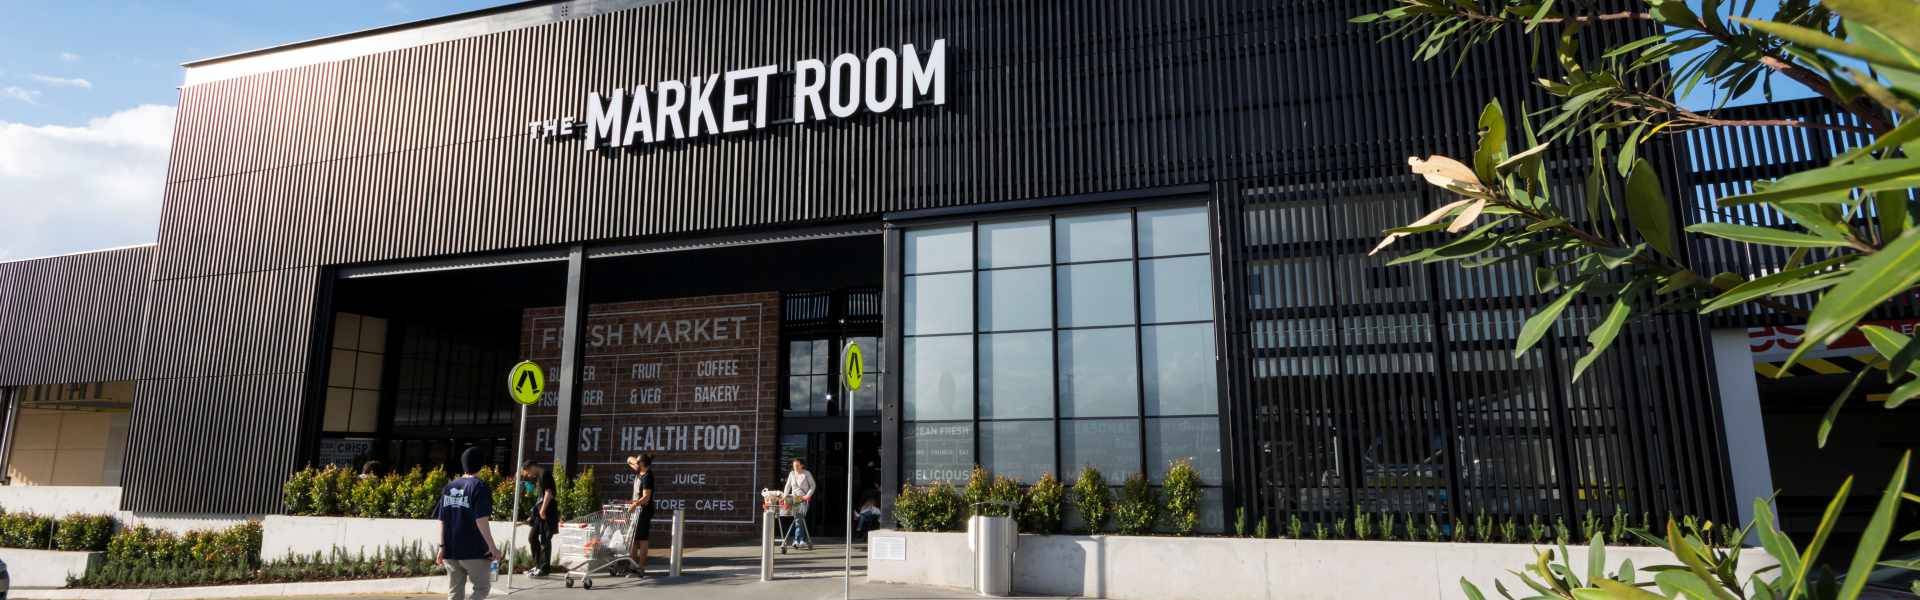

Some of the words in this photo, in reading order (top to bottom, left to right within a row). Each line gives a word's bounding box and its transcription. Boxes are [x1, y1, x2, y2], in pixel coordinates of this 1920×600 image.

[529, 116, 574, 140] THE
[584, 64, 778, 151] MARKET
[793, 39, 946, 124] ROOM
[542, 324, 624, 349] FSH
[632, 315, 747, 345] MARKET
[631, 362, 663, 379] FRUIT
[696, 359, 739, 377] COFFEE
[630, 388, 638, 405] &
[640, 388, 662, 405] VEG
[694, 385, 740, 403] BAKERY
[620, 425, 688, 451] HEALTH
[693, 424, 741, 451] FOOD
[671, 473, 707, 485] JUICE
[914, 468, 971, 481] ELICIOUS
[653, 499, 687, 511] TORE
[694, 499, 736, 511] CAFES
